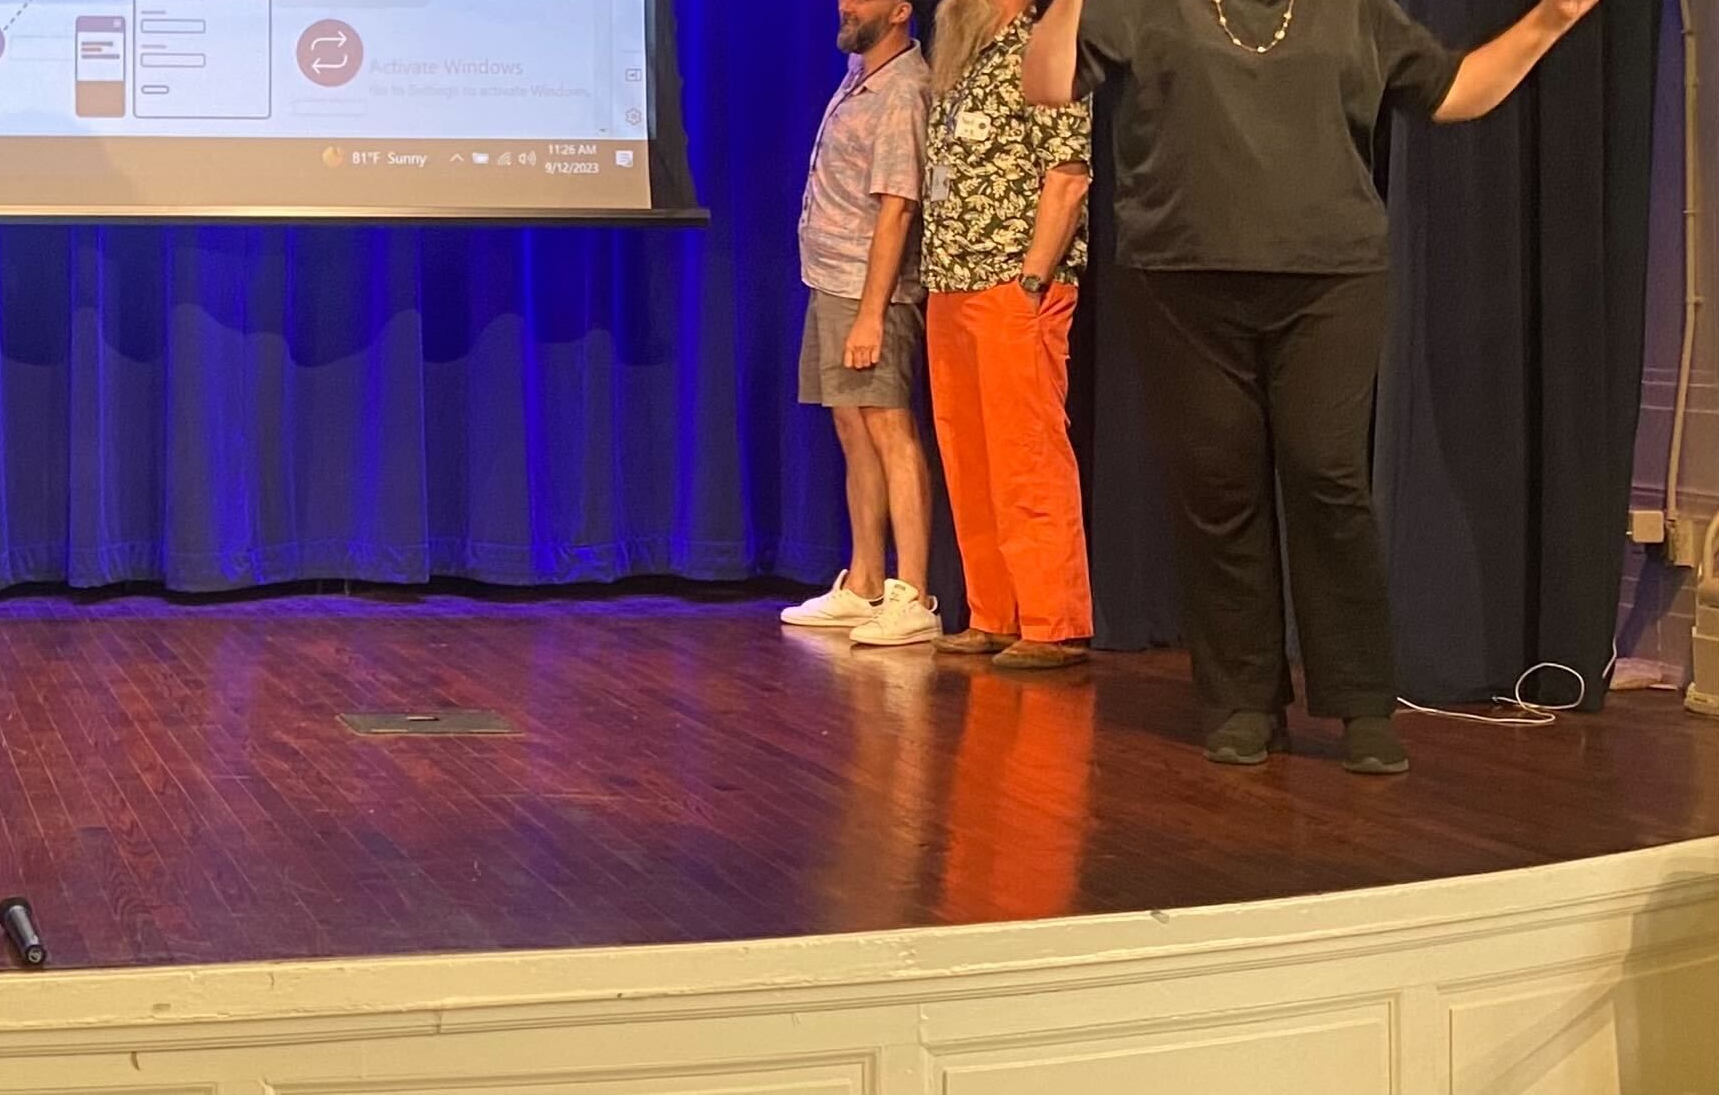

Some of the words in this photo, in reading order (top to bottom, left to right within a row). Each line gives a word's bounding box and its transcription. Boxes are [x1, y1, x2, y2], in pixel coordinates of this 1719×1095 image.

[370, 60, 438, 74] Activate
[444, 59, 523, 74] Windows
[548, 145, 576, 154] 11:26
[578, 145, 597, 154] AM
[388, 152, 427, 166] Sunny
[545, 162, 599, 174] 9/12/2023
